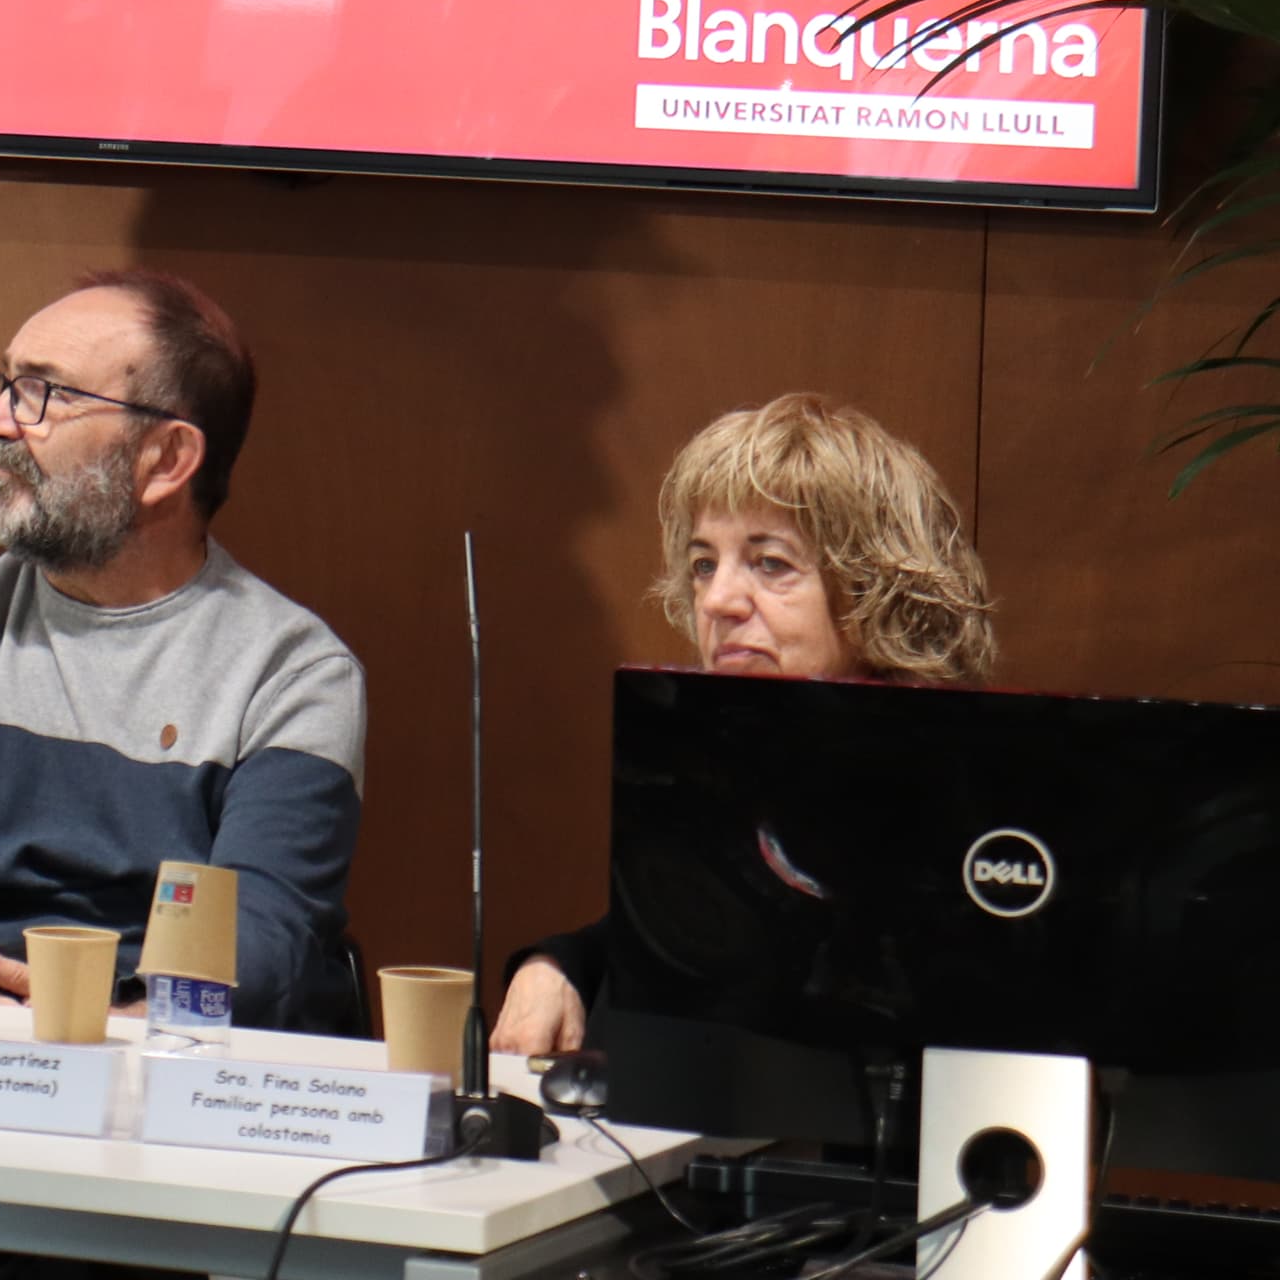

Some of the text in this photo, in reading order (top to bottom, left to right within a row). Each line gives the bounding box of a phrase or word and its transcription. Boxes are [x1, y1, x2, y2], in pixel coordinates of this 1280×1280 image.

[661, 97, 1066, 137] UNIVERSITAT RAMON LLULL
[973, 860, 1044, 886] DELL
[214, 1068, 368, 1098] Sra. Fina Solano
[190, 1091, 385, 1125] Familiar persona amb
[238, 1122, 332, 1146] colostomia
